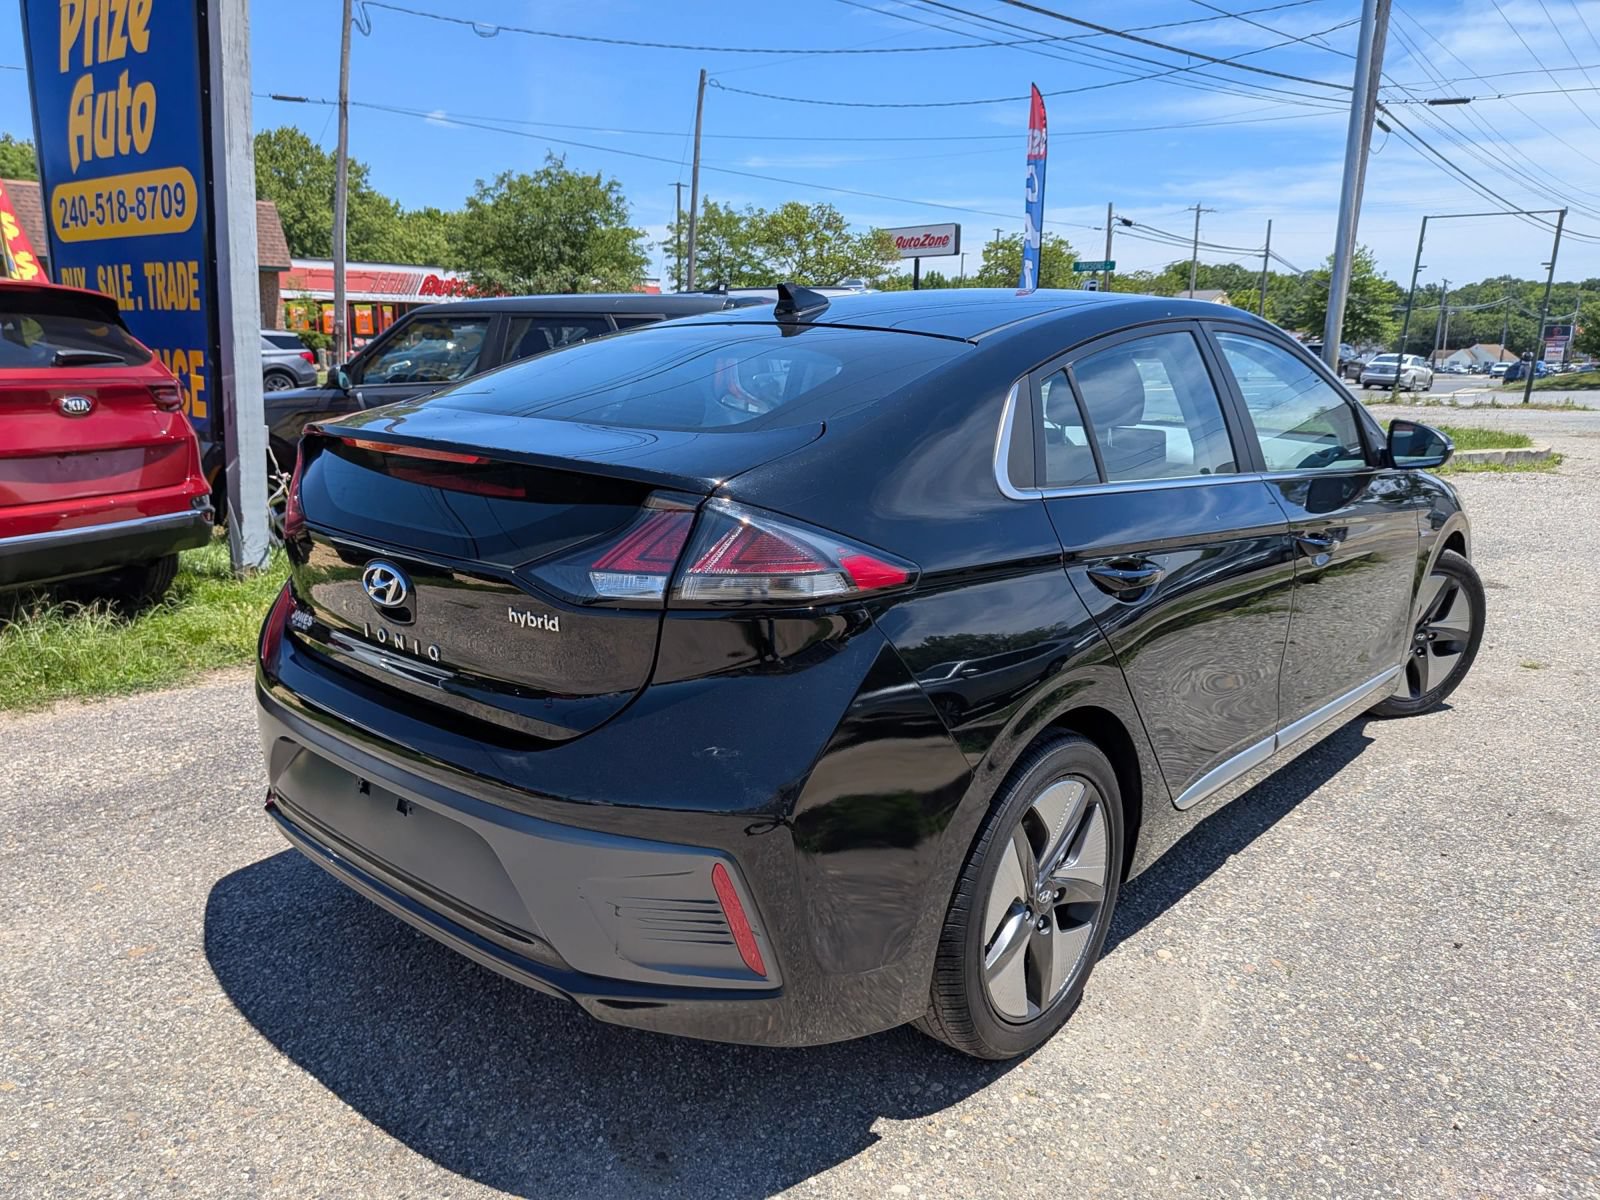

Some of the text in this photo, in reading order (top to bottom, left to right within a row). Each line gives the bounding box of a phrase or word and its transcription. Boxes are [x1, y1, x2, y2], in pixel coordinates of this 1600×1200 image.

[60, 0, 153, 73] Prize
[68, 68, 156, 175] Auto
[59, 182, 186, 229] 240-518-8709
[895, 233, 950, 249] AutoZone
[143, 261, 201, 311] TRADE
[66, 399, 89, 411] KIA
[507, 606, 560, 633] hybrid
[363, 622, 441, 663] IONIQ
